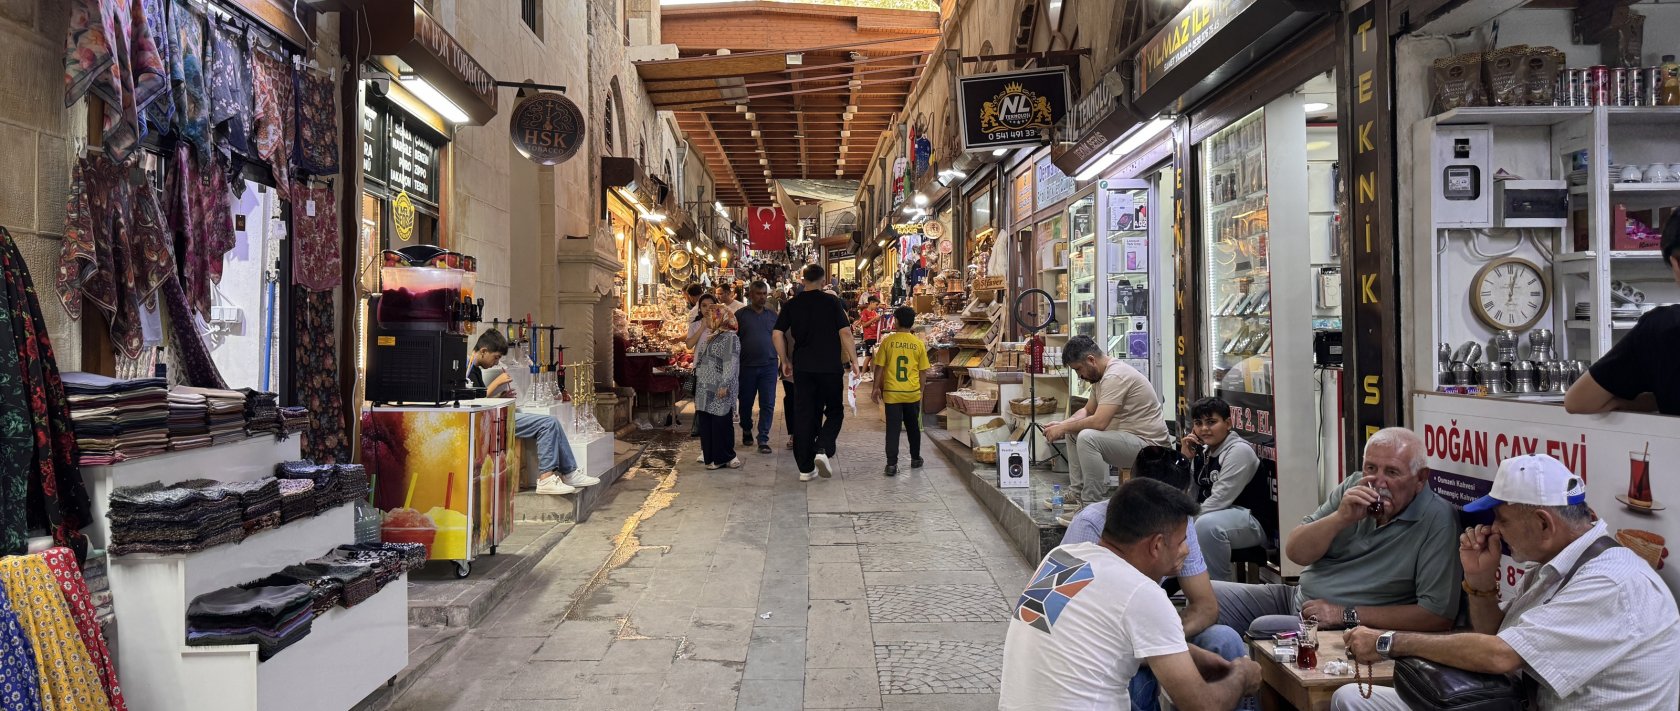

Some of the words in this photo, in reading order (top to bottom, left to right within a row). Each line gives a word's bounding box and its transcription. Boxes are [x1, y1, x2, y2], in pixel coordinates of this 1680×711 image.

[1147, 16, 1190, 73] YILMAZ
[452, 40, 487, 95] TOBACCO
[999, 95, 1031, 120] NL
[525, 129, 567, 148] HSK
[996, 131, 1009, 140] 541
[1011, 130, 1023, 138] 491
[1025, 129, 1035, 138] 33
[527, 144, 564, 155] TOBACCO
[896, 355, 909, 383] 6
[1257, 409, 1273, 436] EL
[1425, 418, 1488, 468] DOĞAN
